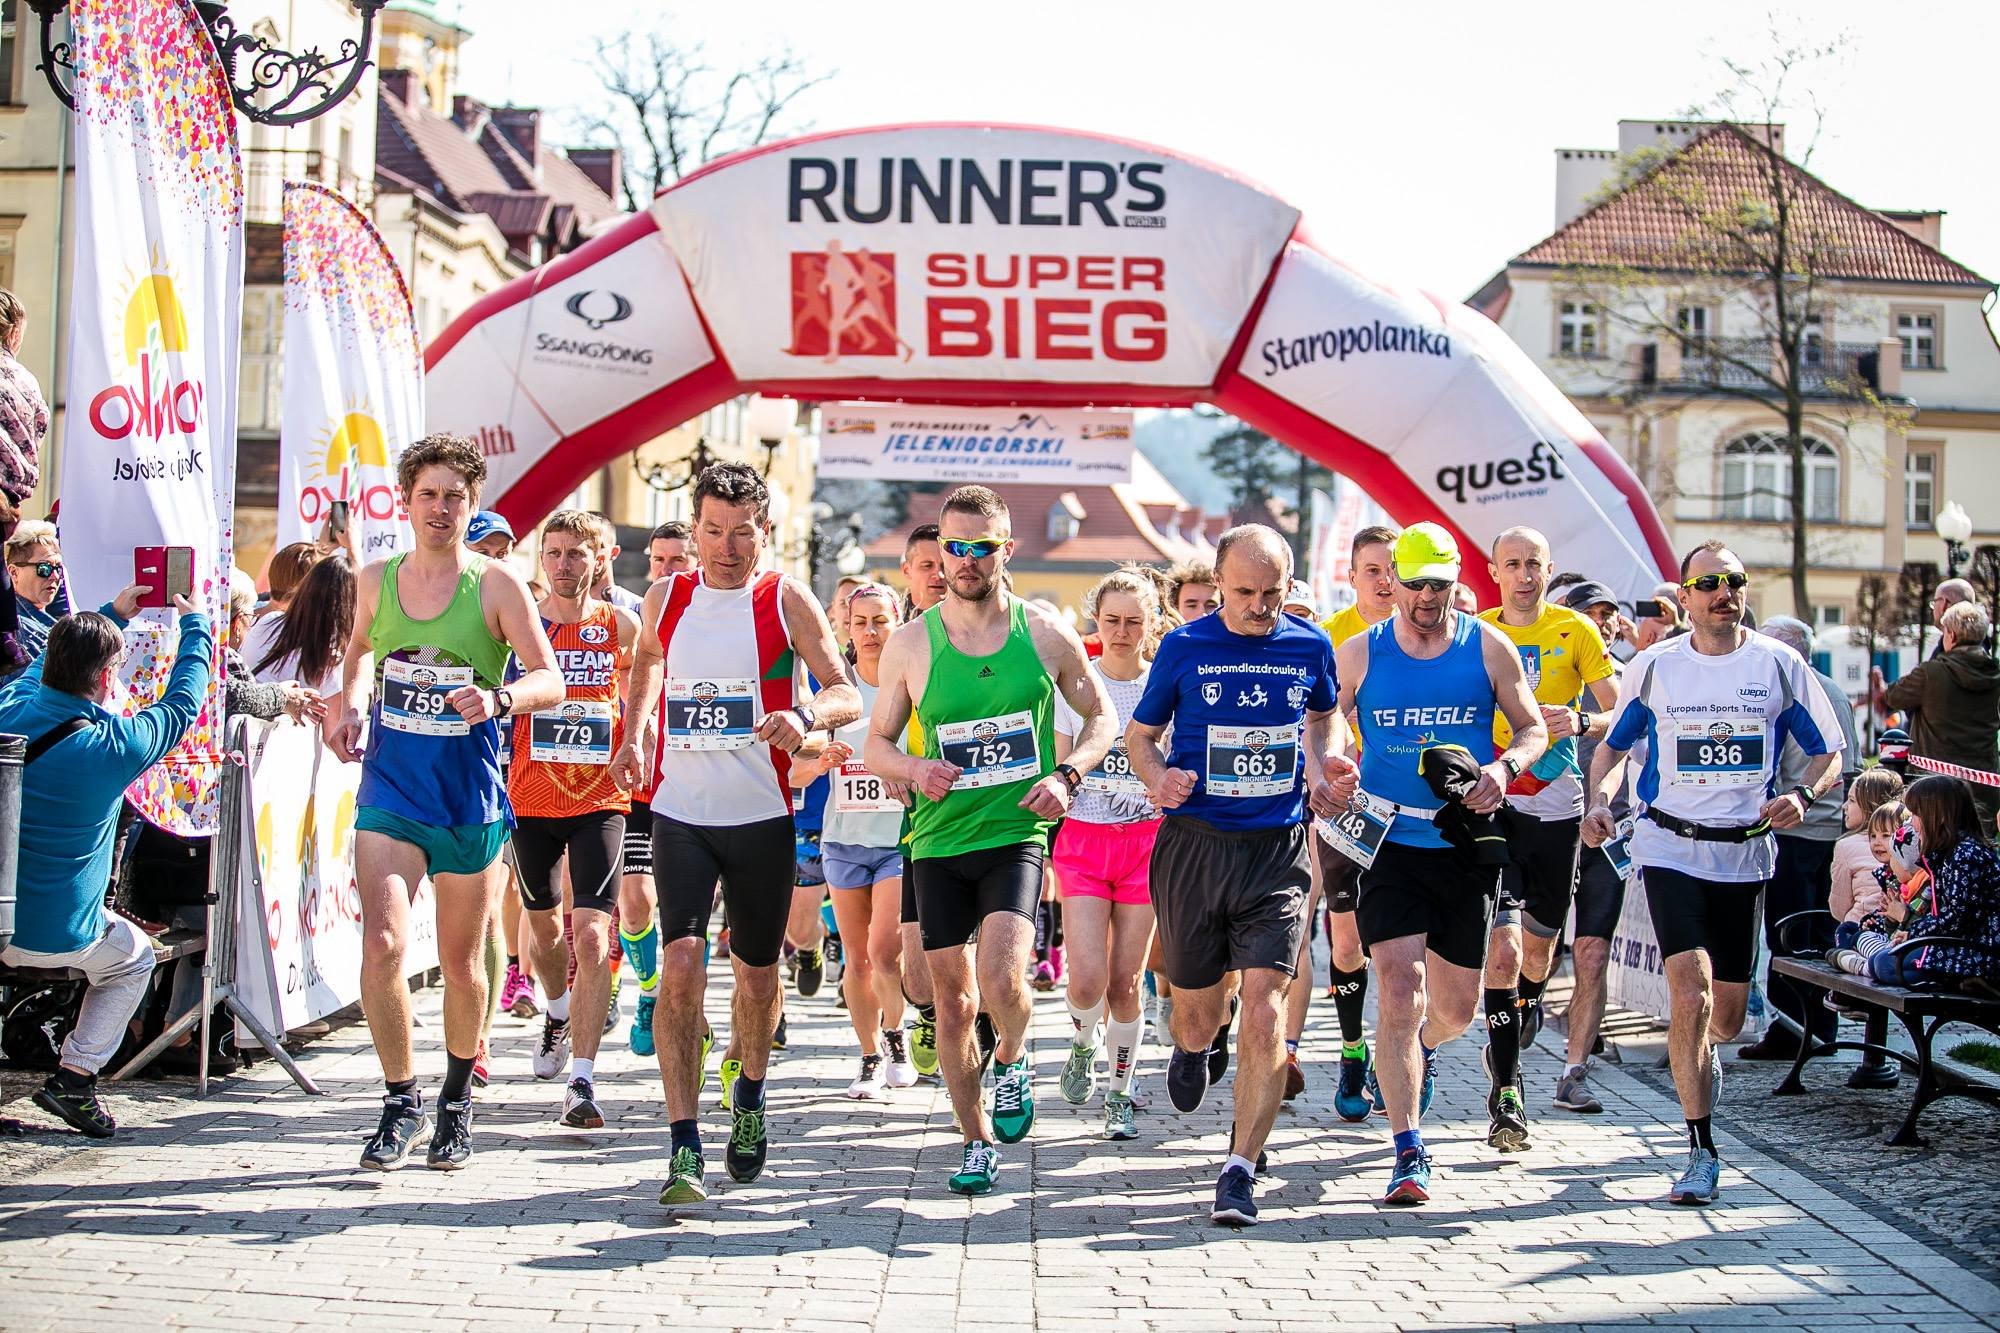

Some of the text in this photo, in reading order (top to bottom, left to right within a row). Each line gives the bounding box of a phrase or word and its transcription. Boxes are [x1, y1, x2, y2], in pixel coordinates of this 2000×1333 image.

[787, 157, 1167, 228] RUNNER'S
[926, 253, 1165, 292] SUPER
[926, 296, 1168, 362] BIEG
[536, 333, 653, 365] SSANGYONG
[1261, 320, 1451, 377] Staropolanka
[1436, 440, 1565, 503] quest
[555, 650, 614, 671] TEAM
[1197, 662, 1307, 677] biegamdlazdrowia.pl
[412, 673, 437, 684] BIEG
[566, 671, 611, 686] ZELEC
[693, 688, 718, 697] BIEG
[1739, 688, 1768, 698] wepa
[402, 690, 445, 715] 759
[1666, 704, 1765, 714] European Sports Team
[407, 712, 437, 721] TOMASZ
[563, 709, 585, 717] BIEG
[684, 707, 728, 729] 758
[1373, 706, 1477, 726] TS REGLE
[553, 725, 593, 745] 779
[973, 726, 999, 737] BIEG
[1244, 735, 1269, 744] BIEG
[1709, 728, 1734, 736] BIEG
[966, 742, 1013, 767] 752
[1699, 745, 1743, 766] 936
[1233, 754, 1276, 775] 663
[1105, 773, 1138, 782] KAROLINA
[1237, 775, 1272, 783] ZBIGNIEW
[844, 779, 880, 800] 158
[1338, 981, 1360, 997] RB
[1489, 1011, 1512, 1030] RB
